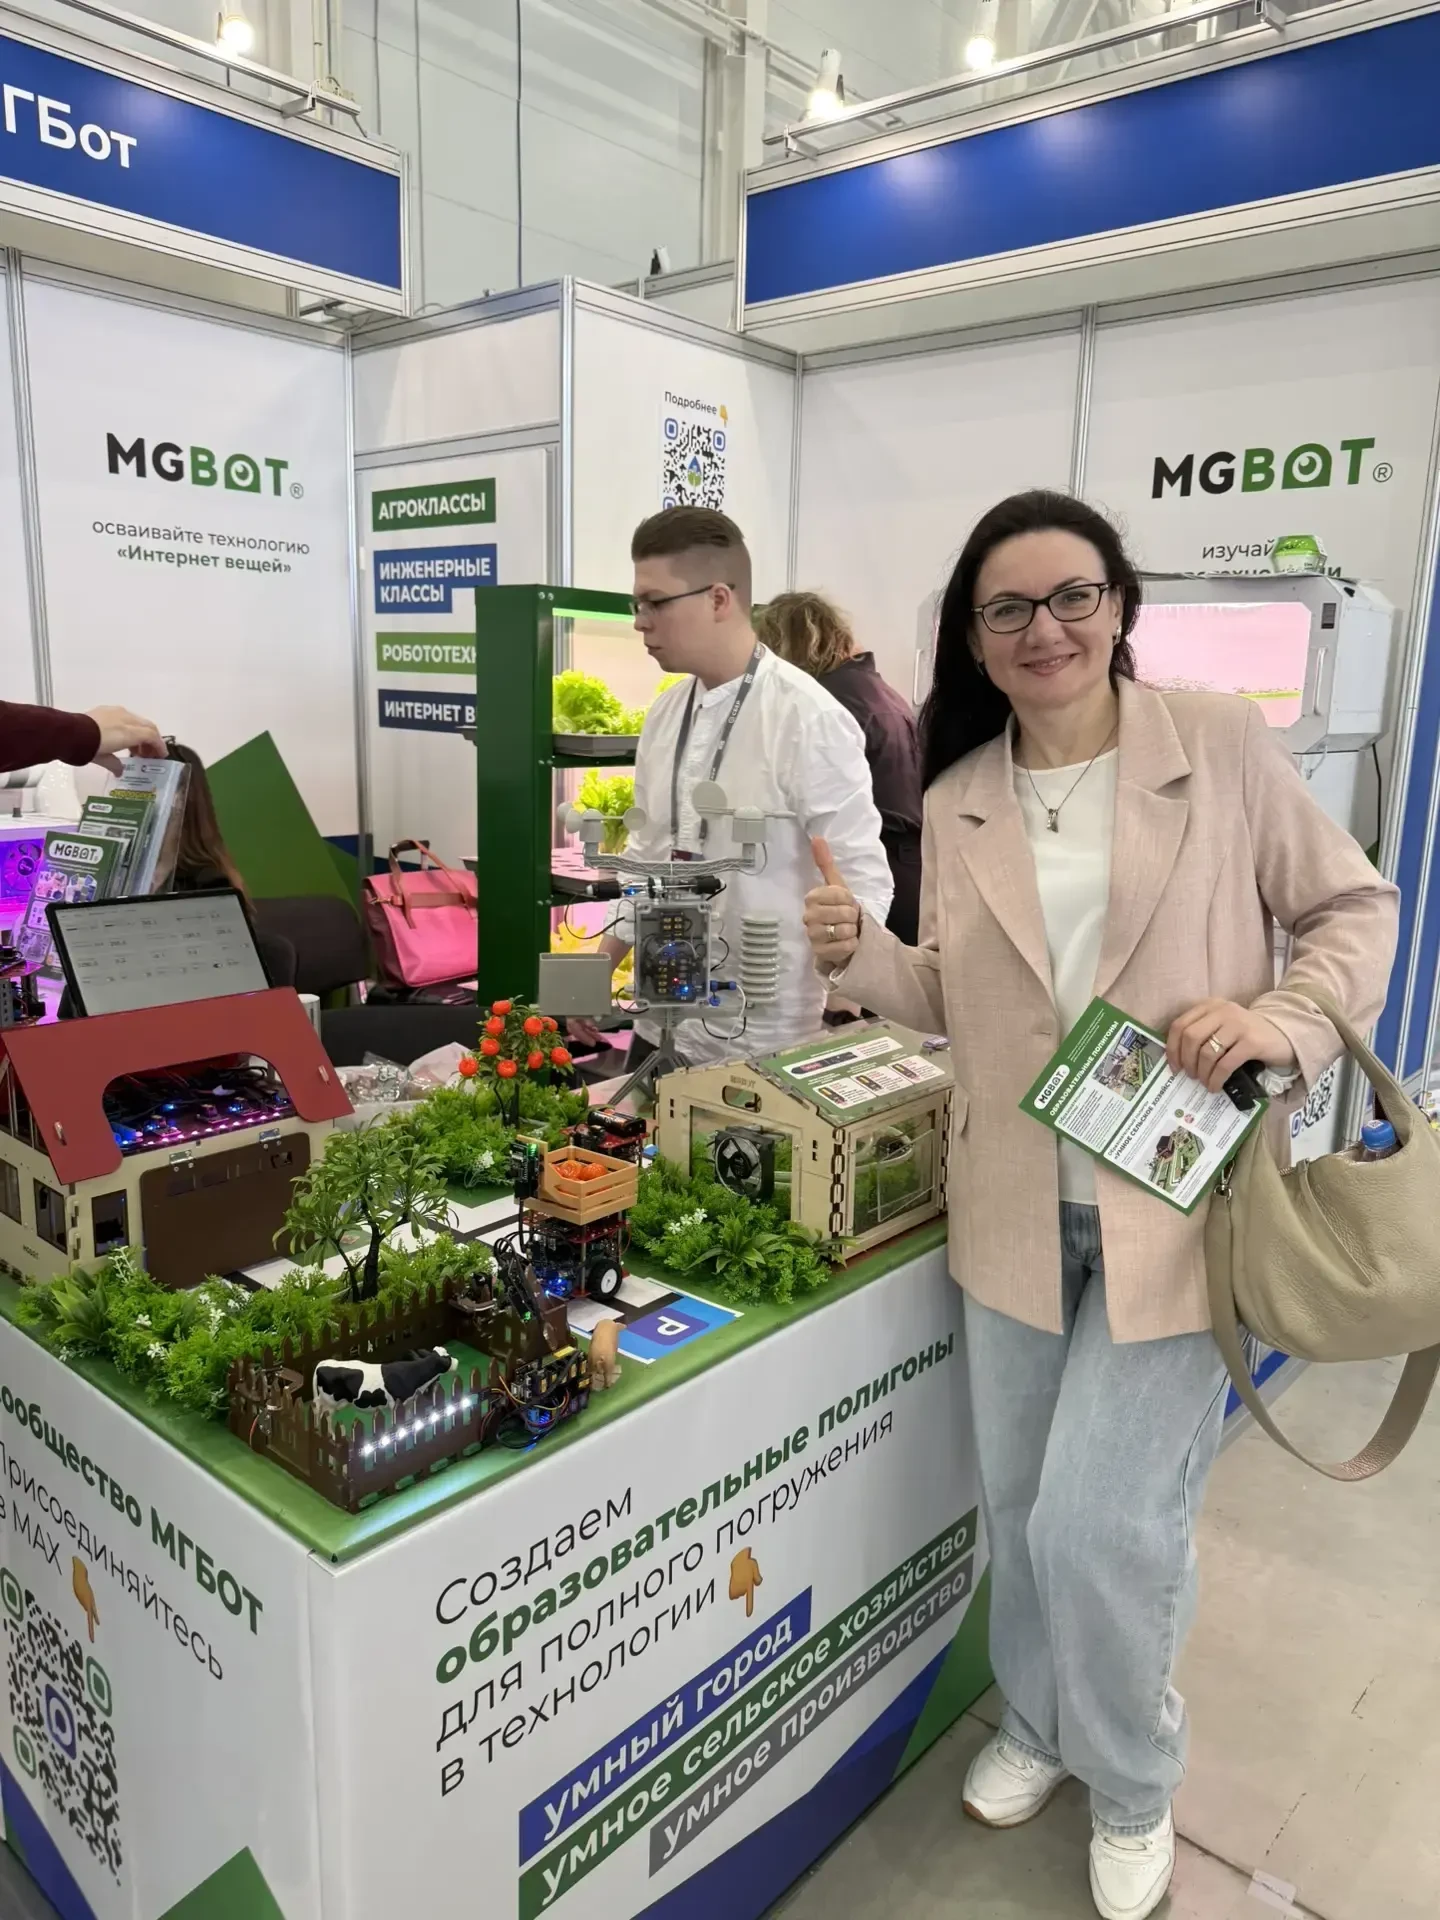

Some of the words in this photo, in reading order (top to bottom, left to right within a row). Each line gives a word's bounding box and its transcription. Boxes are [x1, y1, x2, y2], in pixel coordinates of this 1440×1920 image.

[3, 83, 138, 168] ГБот
[664, 391, 718, 415] Подробнее
[92, 520, 203, 544] осваивайте
[208, 532, 310, 555] технологию
[378, 492, 486, 520] АГРОКЛАССЫ
[117, 545, 219, 568] «Интернет
[225, 557, 292, 574] вещей»
[379, 558, 491, 580] ИНЖЕНЕРНЫЕ
[380, 584, 445, 603] КЛАССЫ
[384, 701, 462, 722] ИНТЕРНЕТ
[1048, 1055, 1095, 1117] ОБРАЗОВАТЕЛЬНЫЕ
[1091, 1021, 1120, 1057] ПОЛИГОНЫ
[1129, 1105, 1154, 1136] СЕЛЬСКОЕ
[0, 1385, 142, 1527] ообщество
[150, 1505, 263, 1636] МГБОТ
[435, 1425, 810, 1684] образовательные
[817, 1332, 955, 1439] полигоны
[435, 1486, 632, 1625] Создаем
[436, 1660, 522, 1753] для
[541, 1542, 704, 1674] полного
[716, 1410, 893, 1553] погружения
[441, 1756, 465, 1797] в
[478, 1577, 715, 1764] технологии
[541, 1771, 672, 1906] умное
[683, 1636, 830, 1775] сельское
[837, 1526, 968, 1648] хозяйство
[543, 1695, 684, 1841] умный
[696, 1614, 793, 1712] город
[662, 1740, 771, 1859] умное
[781, 1572, 966, 1747] производство
